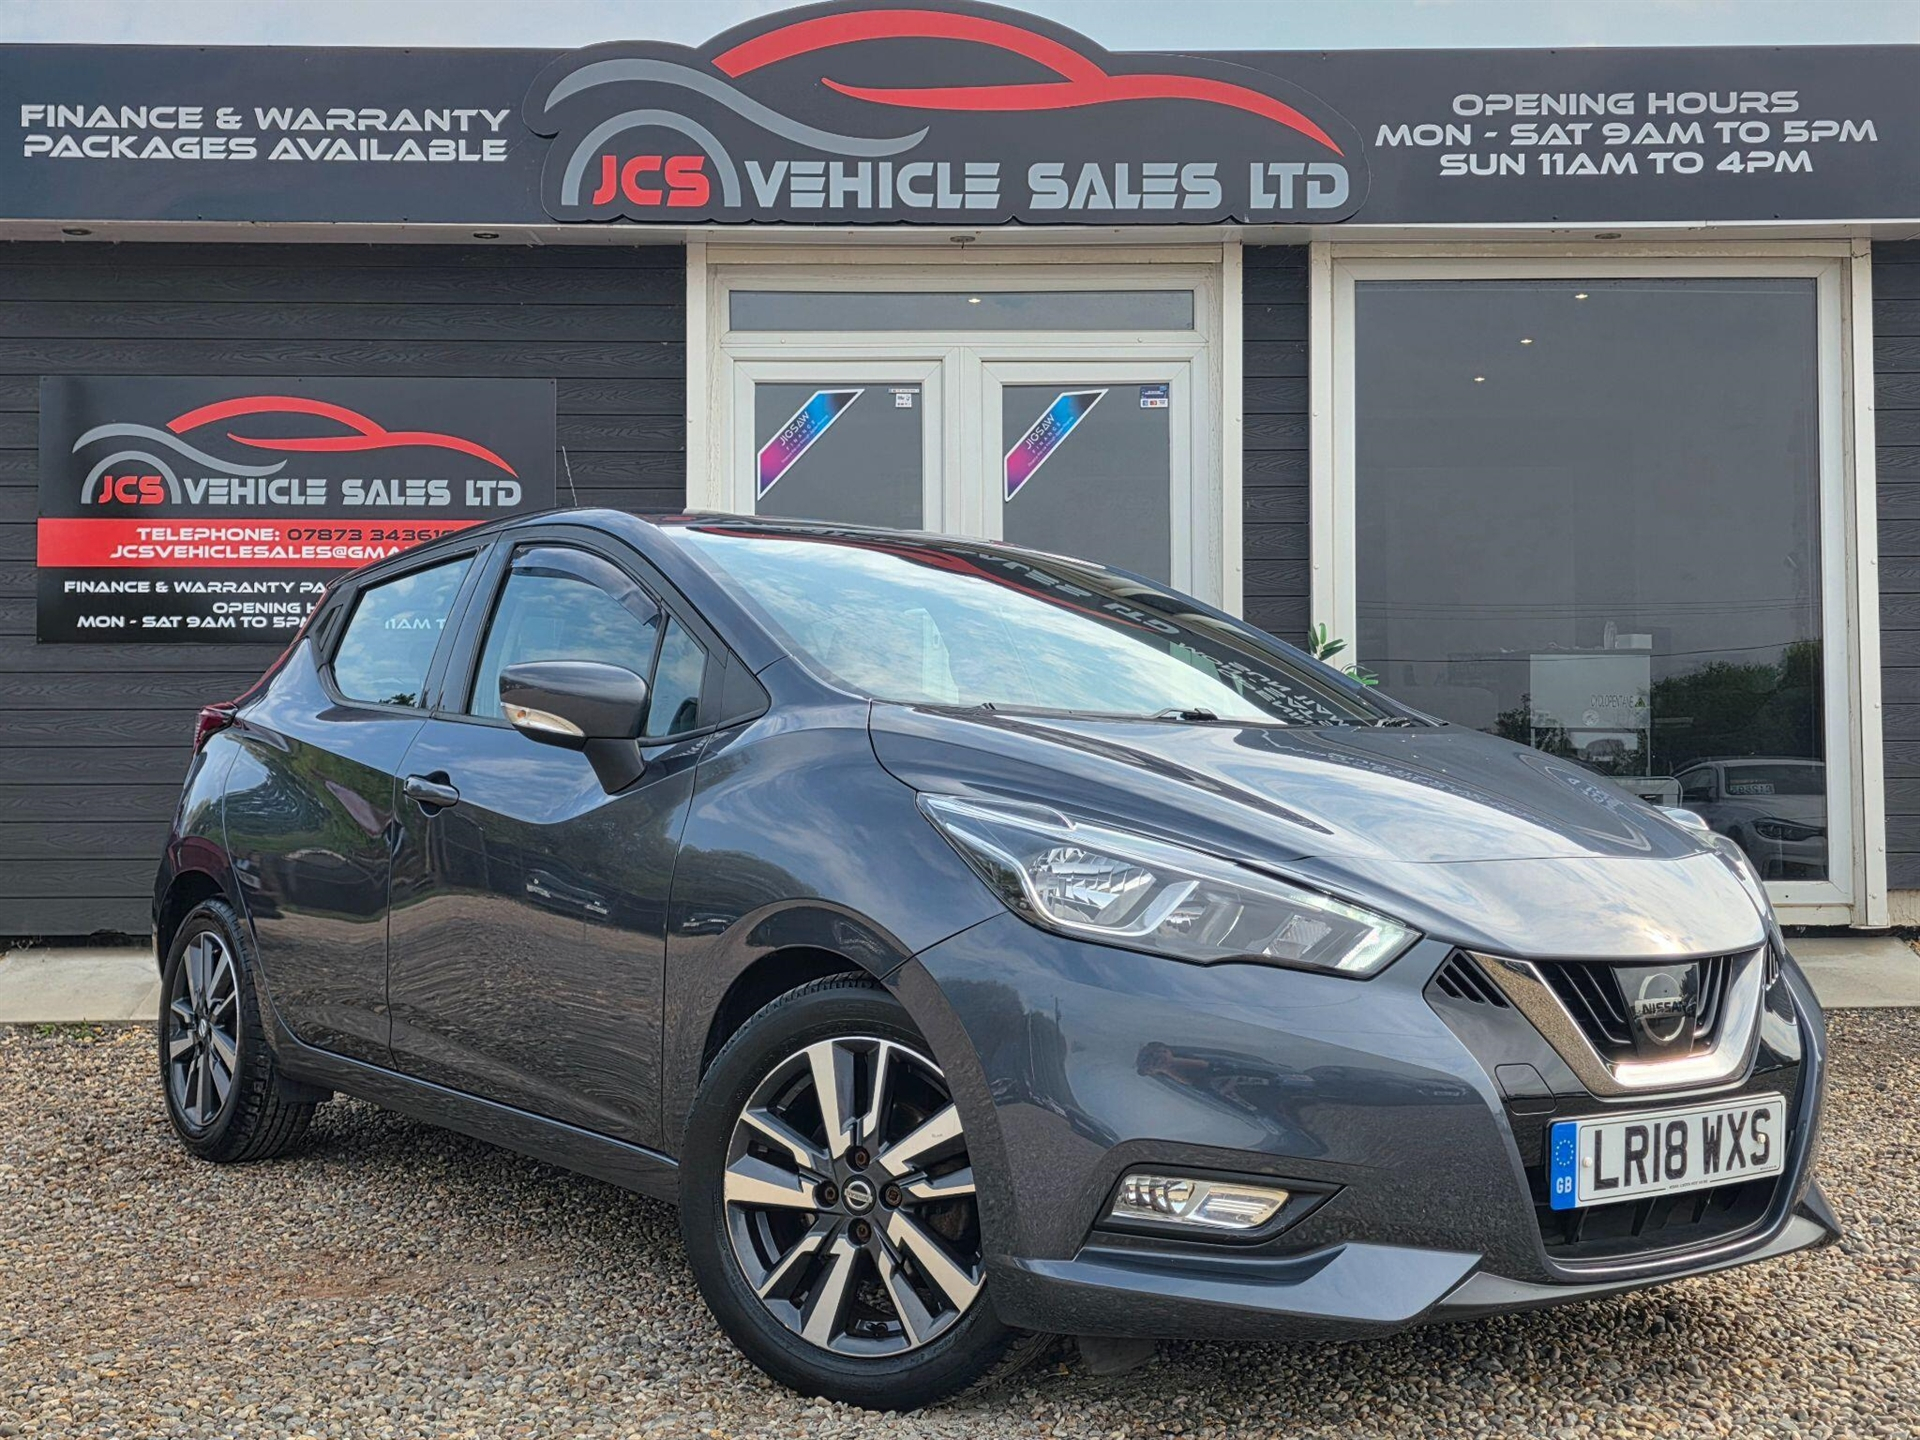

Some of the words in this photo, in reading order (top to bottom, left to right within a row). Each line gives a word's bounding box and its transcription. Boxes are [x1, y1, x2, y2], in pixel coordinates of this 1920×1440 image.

[1453, 93, 1635, 117] OPENING
[1649, 91, 1800, 115] HOURS
[21, 104, 204, 130] FINANCE
[216, 107, 243, 130] &
[254, 107, 511, 132] WARRANTY
[1375, 124, 1473, 147] MON
[1510, 124, 1593, 147] SAT
[1602, 122, 1706, 146] 9AM
[1714, 121, 1771, 145] TO
[1783, 120, 1879, 143] 5PM
[24, 135, 258, 160] PACKAGES
[268, 138, 509, 163] AVAILABLE
[1440, 154, 1527, 177] SUN
[1538, 153, 1640, 176] 11AM
[1648, 152, 1705, 175] TO
[1716, 151, 1815, 174] 4PM
[592, 155, 708, 208] JCS
[742, 161, 1002, 210] VEHICLE
[1028, 162, 1223, 211] SALES
[1250, 162, 1351, 210] LTD
[780, 411, 810, 446] JIGSAW
[1025, 413, 1055, 449] JIGSAW
[98, 475, 166, 506] JCS
[182, 477, 328, 506] VEHICLE
[341, 479, 452, 507] SALES
[465, 479, 523, 507] LTD
[136, 527, 281, 542] TELEPHONE:
[287, 529, 364, 542] 07873
[109, 545, 408, 560] JCSVEHICLESALES@GMA
[64, 581, 152, 594] FINANCE
[155, 582, 170, 594] &
[174, 581, 297, 595] WARRANTY
[76, 615, 126, 628] MON
[142, 616, 184, 628] SAT
[187, 616, 236, 628] 9AM
[240, 616, 269, 628] TO
[213, 602, 302, 615] OPENING
[1593, 1120, 1689, 1191] LR18
[1701, 1107, 1771, 1176] WXS
[1556, 1176, 1573, 1194] GB
